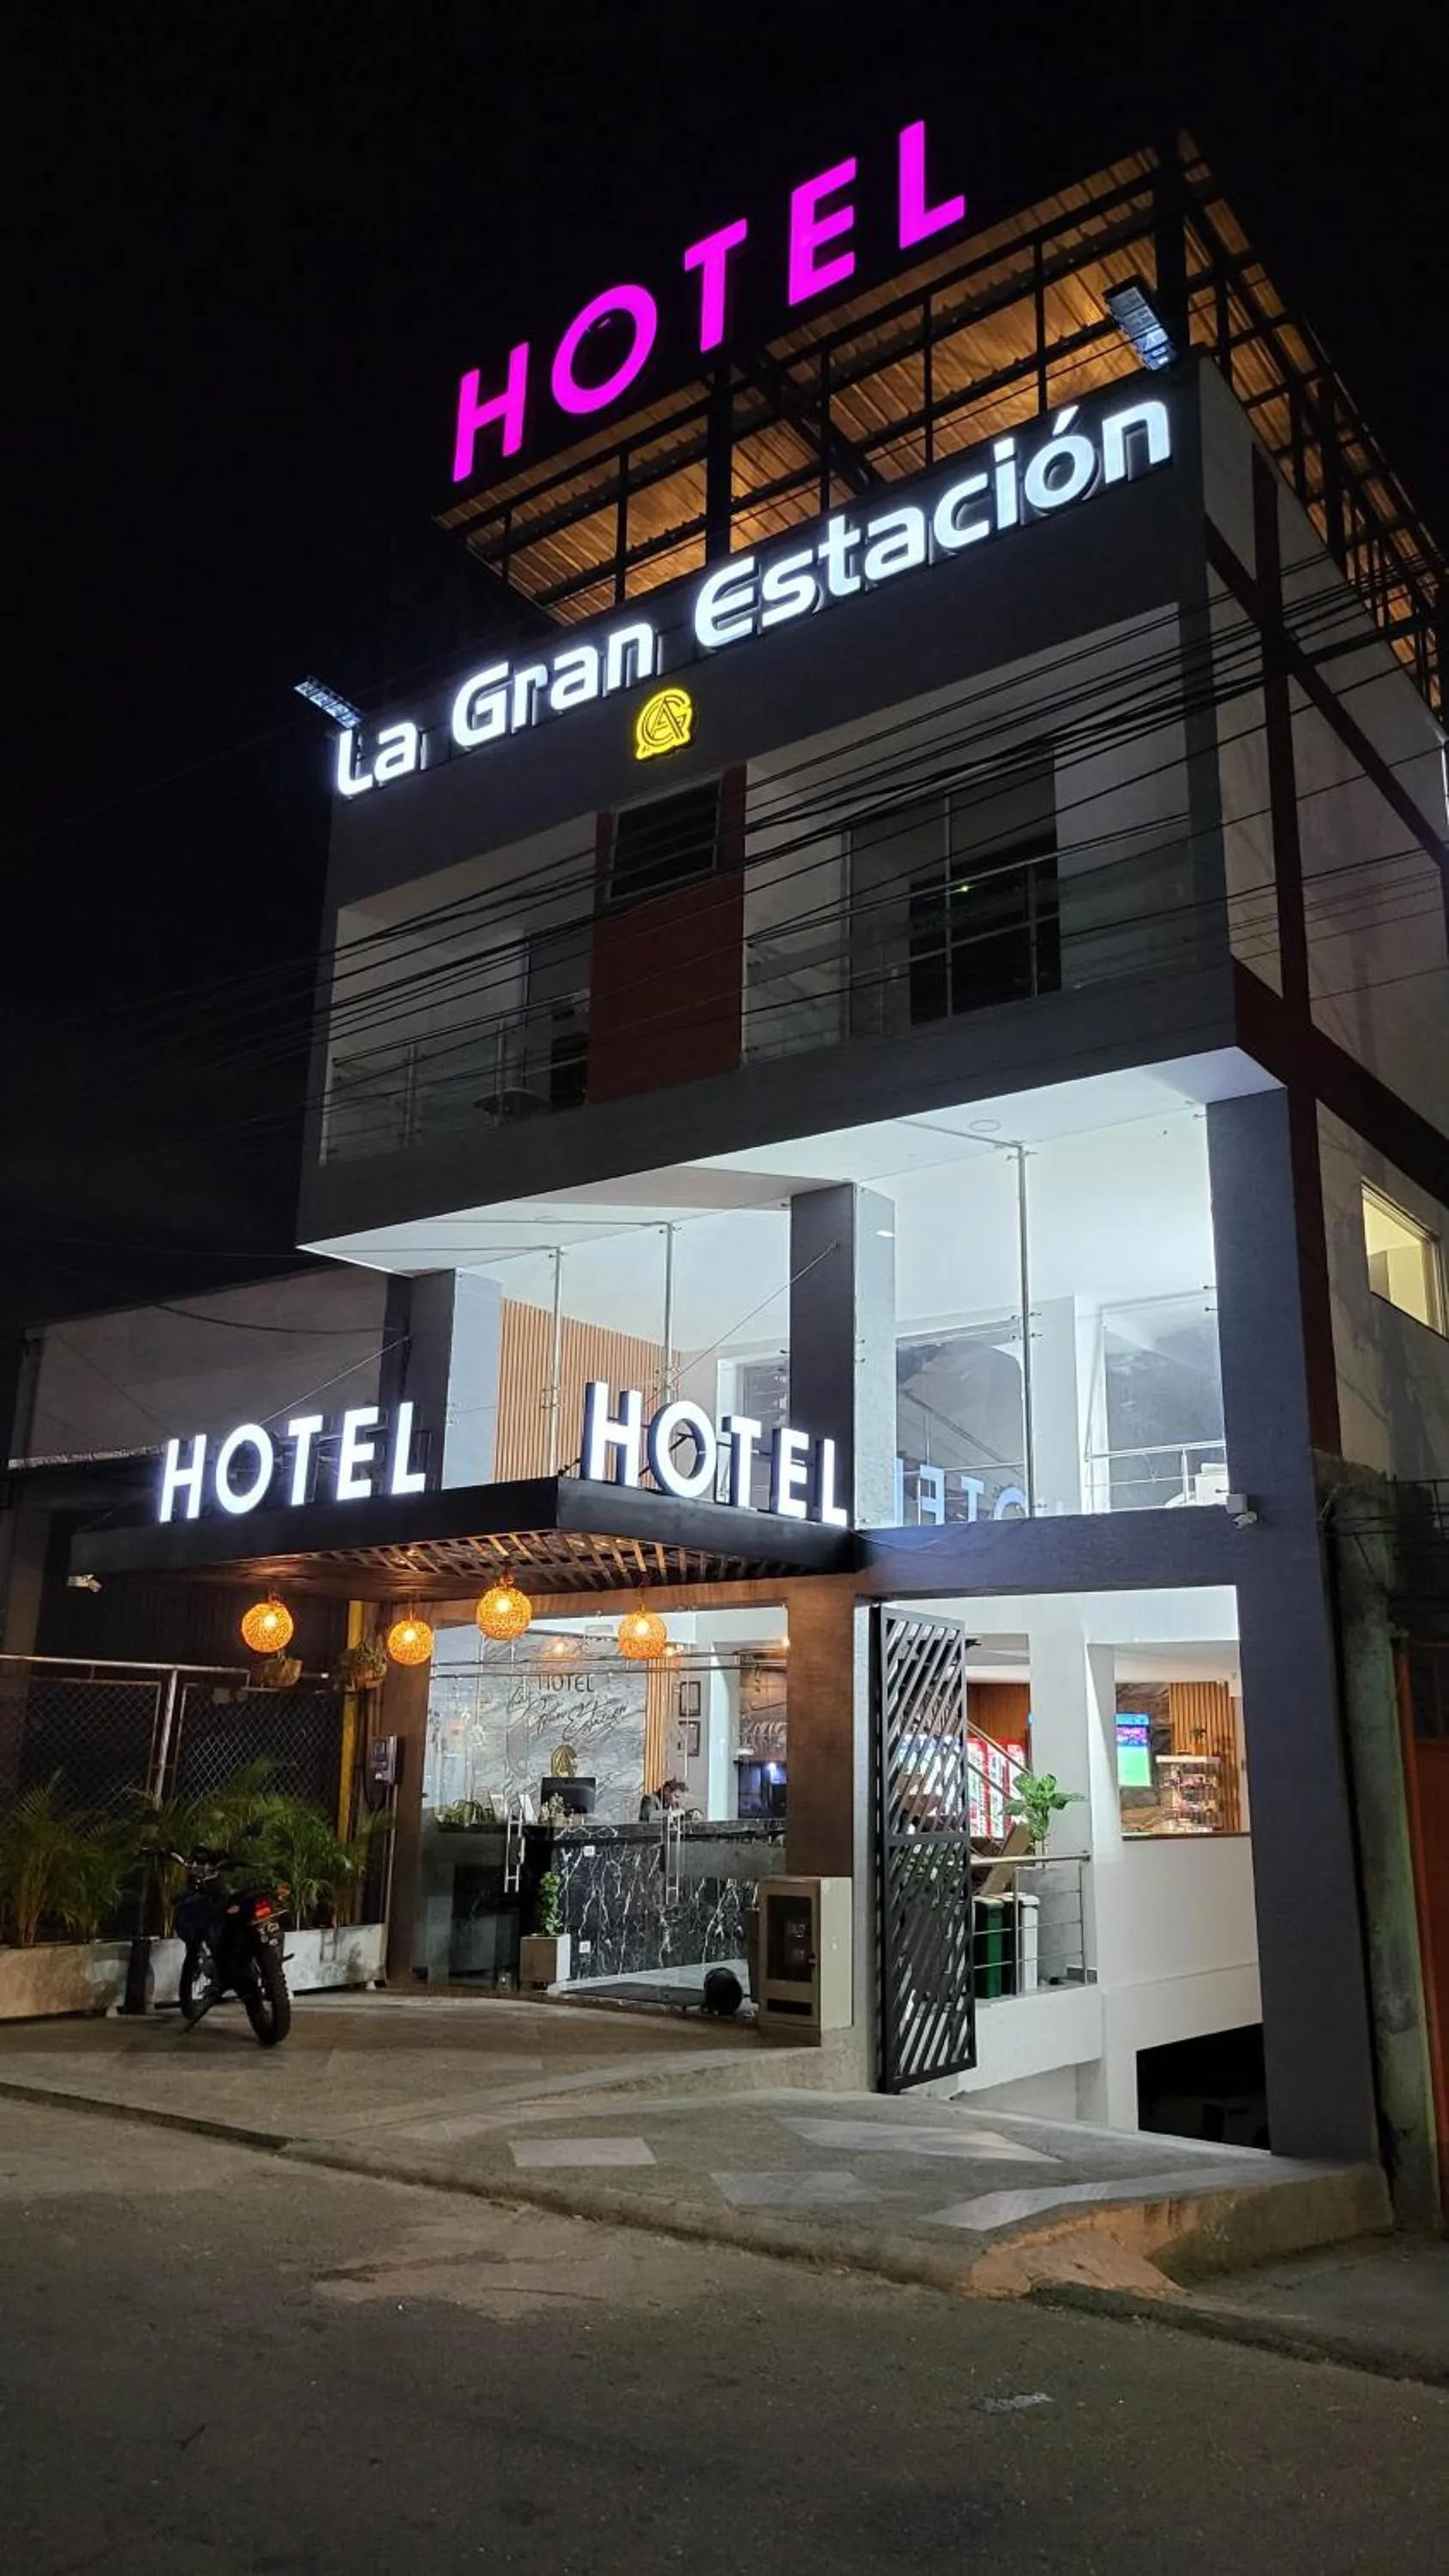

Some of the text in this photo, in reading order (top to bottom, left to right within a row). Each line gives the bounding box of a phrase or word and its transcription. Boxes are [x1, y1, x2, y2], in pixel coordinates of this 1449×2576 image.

[452, 120, 967, 483] HOTEL
[336, 400, 1171, 797] La Gran Estación
[159, 1401, 427, 1522] HOTEL
[583, 1381, 850, 1528] HOTEL
[537, 1673, 595, 1692] HOTEL
